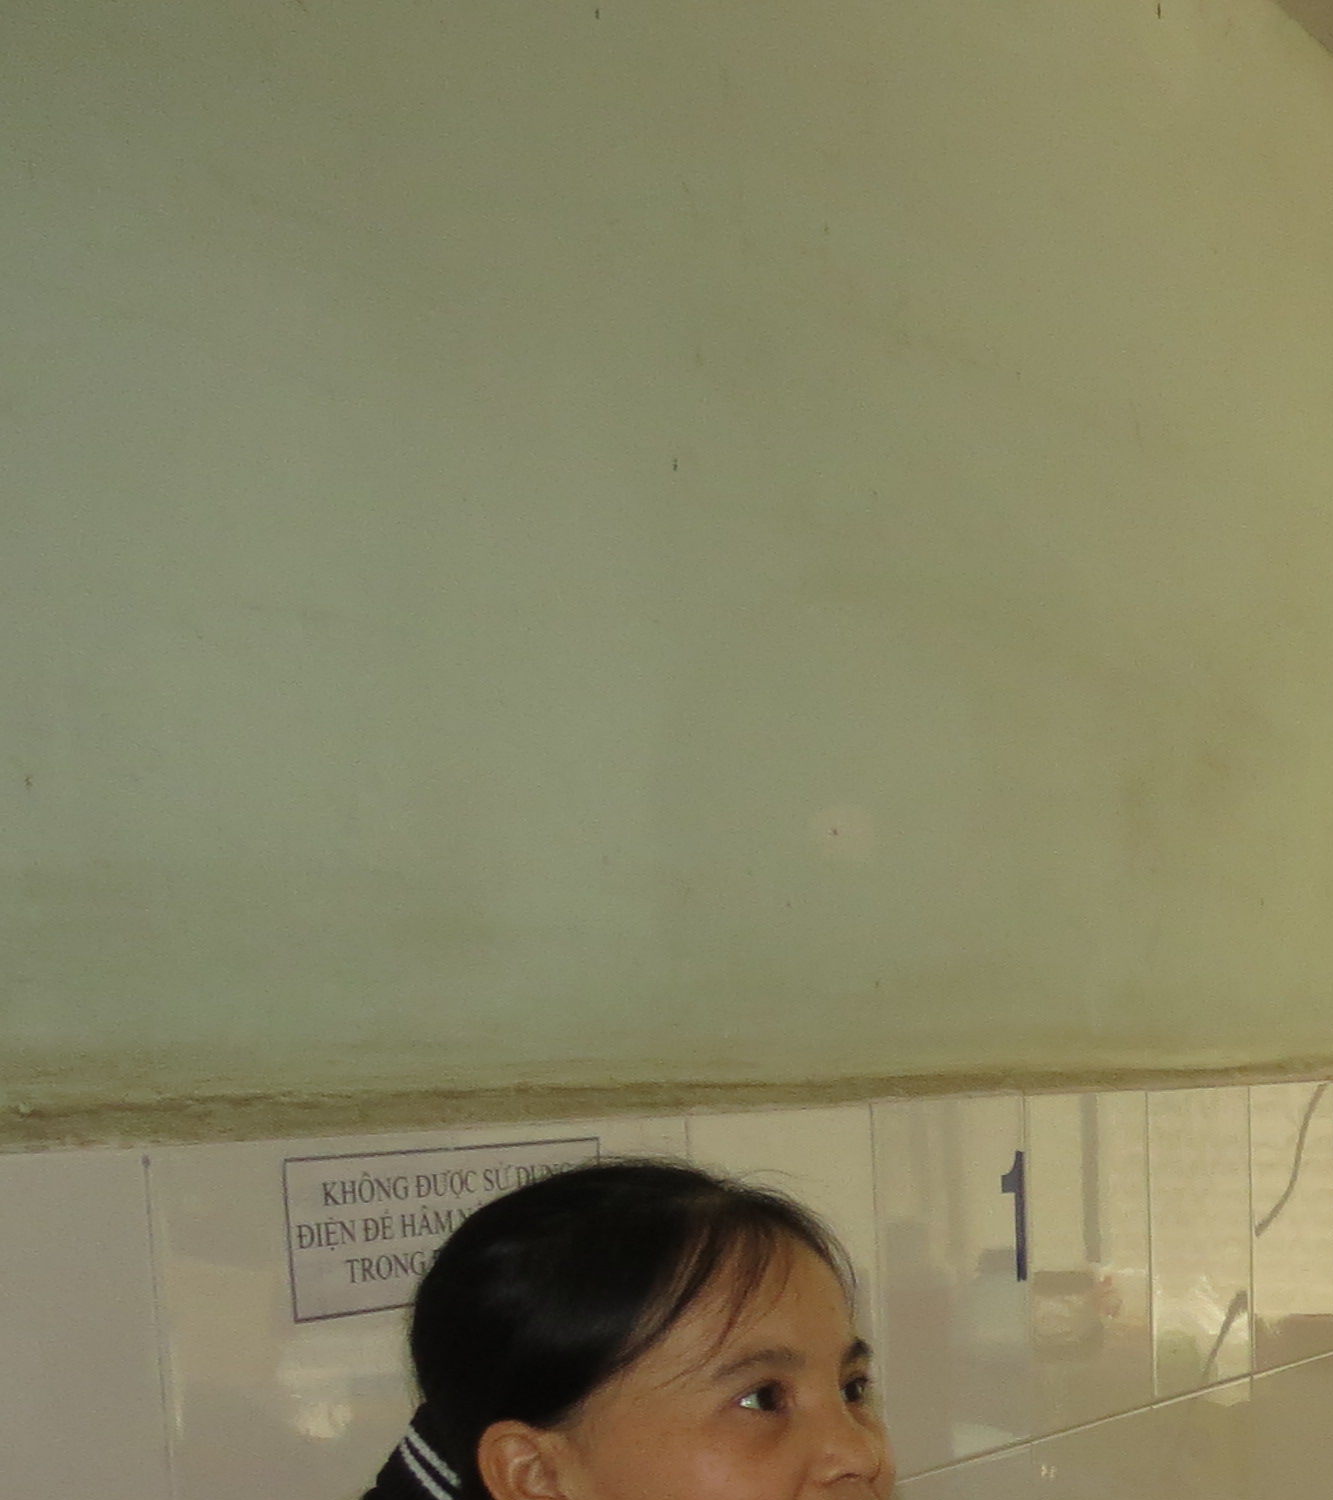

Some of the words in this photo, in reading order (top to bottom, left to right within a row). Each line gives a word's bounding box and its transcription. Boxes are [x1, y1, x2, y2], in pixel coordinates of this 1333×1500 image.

[322, 1171, 408, 1206] KHÔNG
[415, 1168, 477, 1199] ĐƯỢC
[1001, 1150, 1027, 1281] 1
